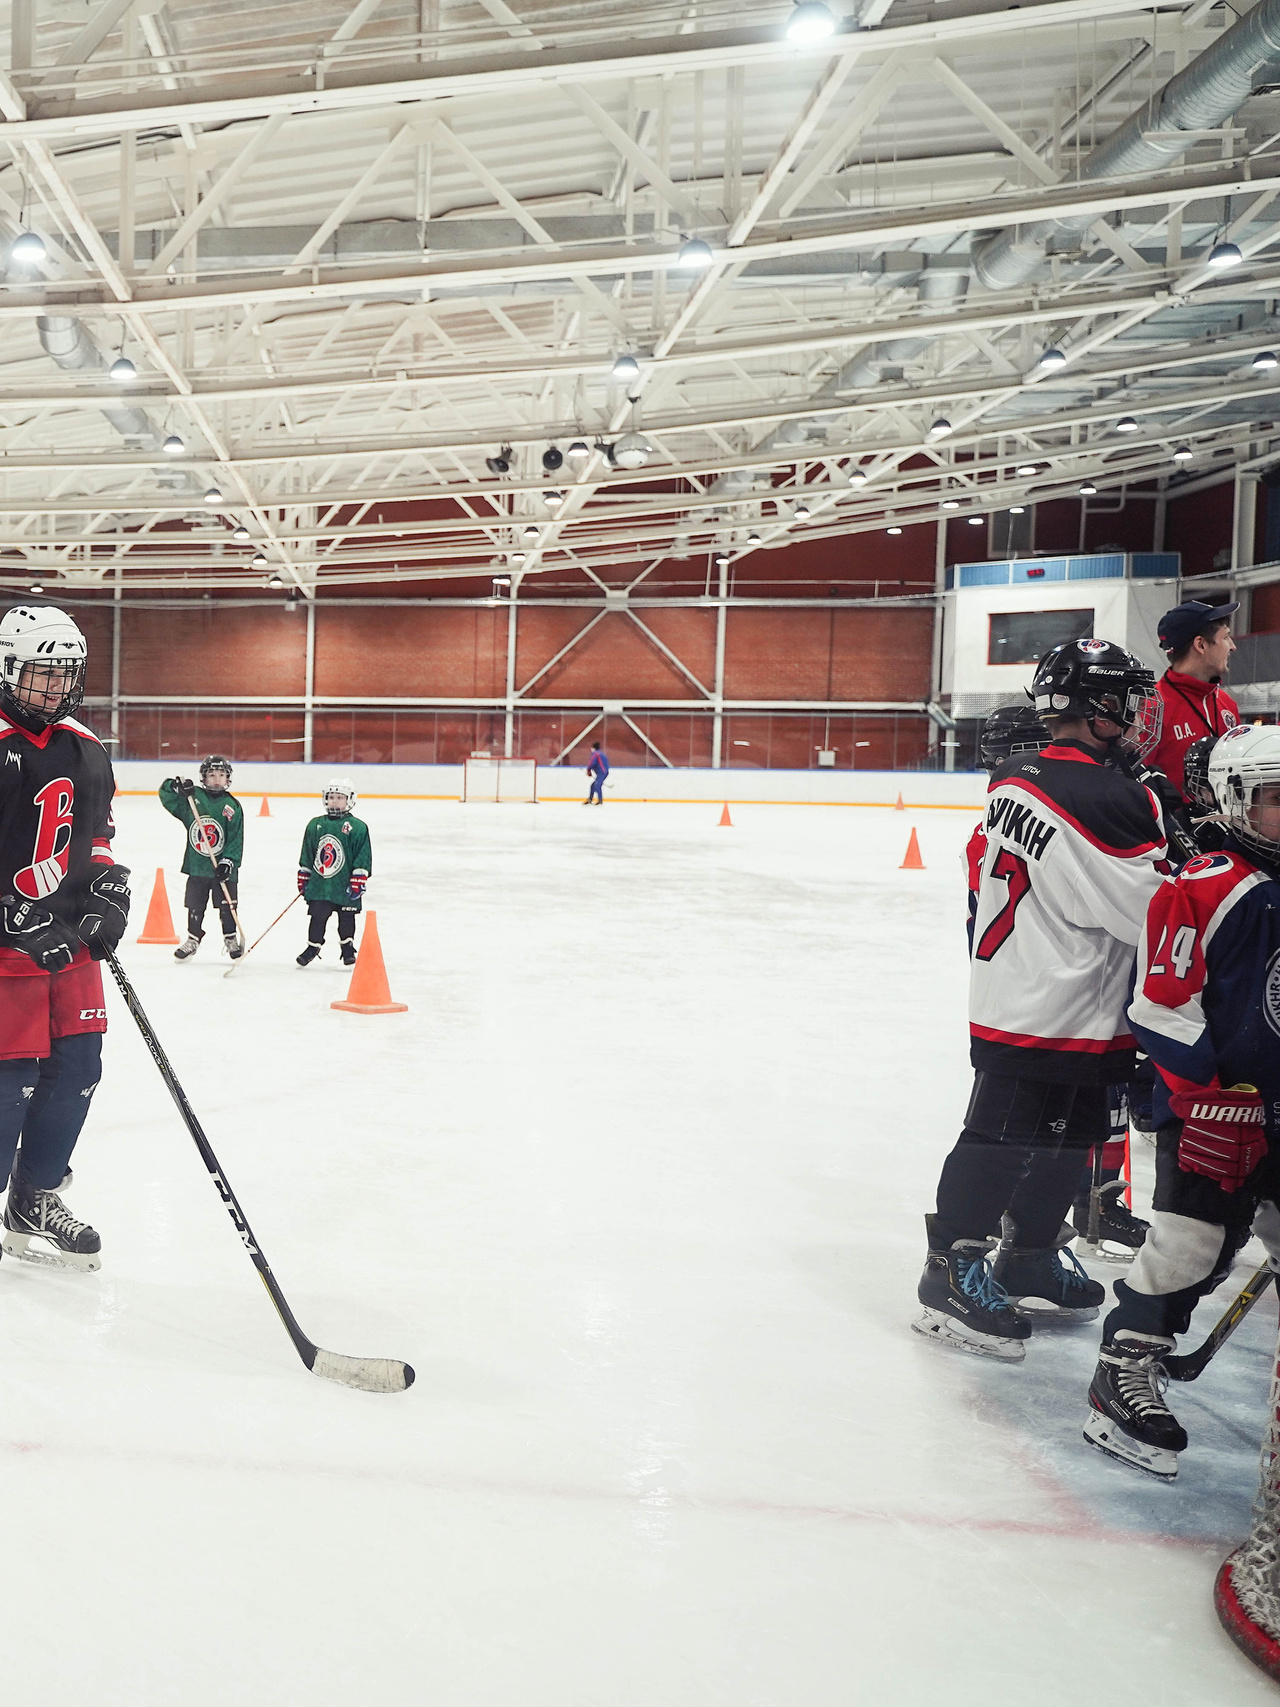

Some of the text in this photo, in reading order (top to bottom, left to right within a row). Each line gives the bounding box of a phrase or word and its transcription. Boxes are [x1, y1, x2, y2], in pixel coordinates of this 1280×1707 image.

[1088, 667, 1125, 677] BAUER
[1173, 722, 1196, 741] D.A.
[1021, 764, 1041, 776] LUTCH
[144, 1033, 162, 1065] TACKS
